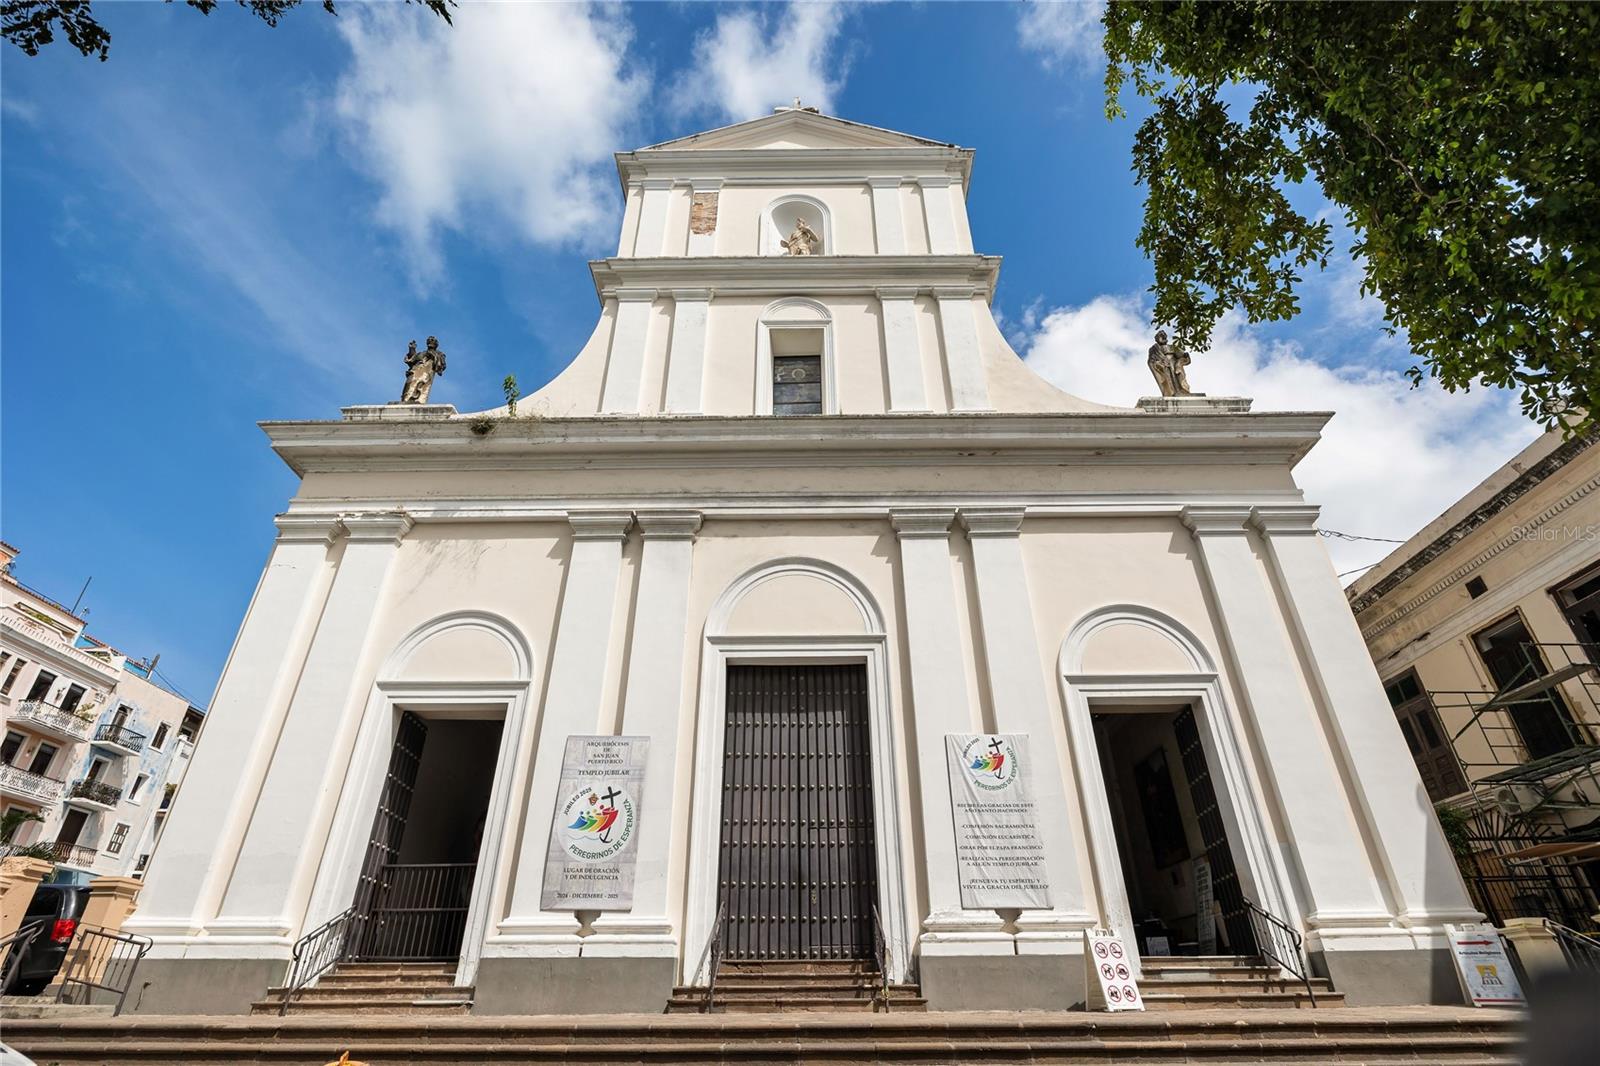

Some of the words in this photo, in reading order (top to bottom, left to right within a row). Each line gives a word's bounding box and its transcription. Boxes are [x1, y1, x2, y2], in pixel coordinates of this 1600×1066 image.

[1006, 746, 1018, 778] ESPERANZA
[974, 780, 1008, 791] PEREGRINOS
[1006, 776, 1013, 784] DE
[564, 794, 580, 815] JUBILEO
[580, 787, 592, 797] 2025
[569, 844, 613, 859] PEREGRINOS
[613, 841, 623, 851] DE
[621, 798, 633, 842] ESPERANZA
